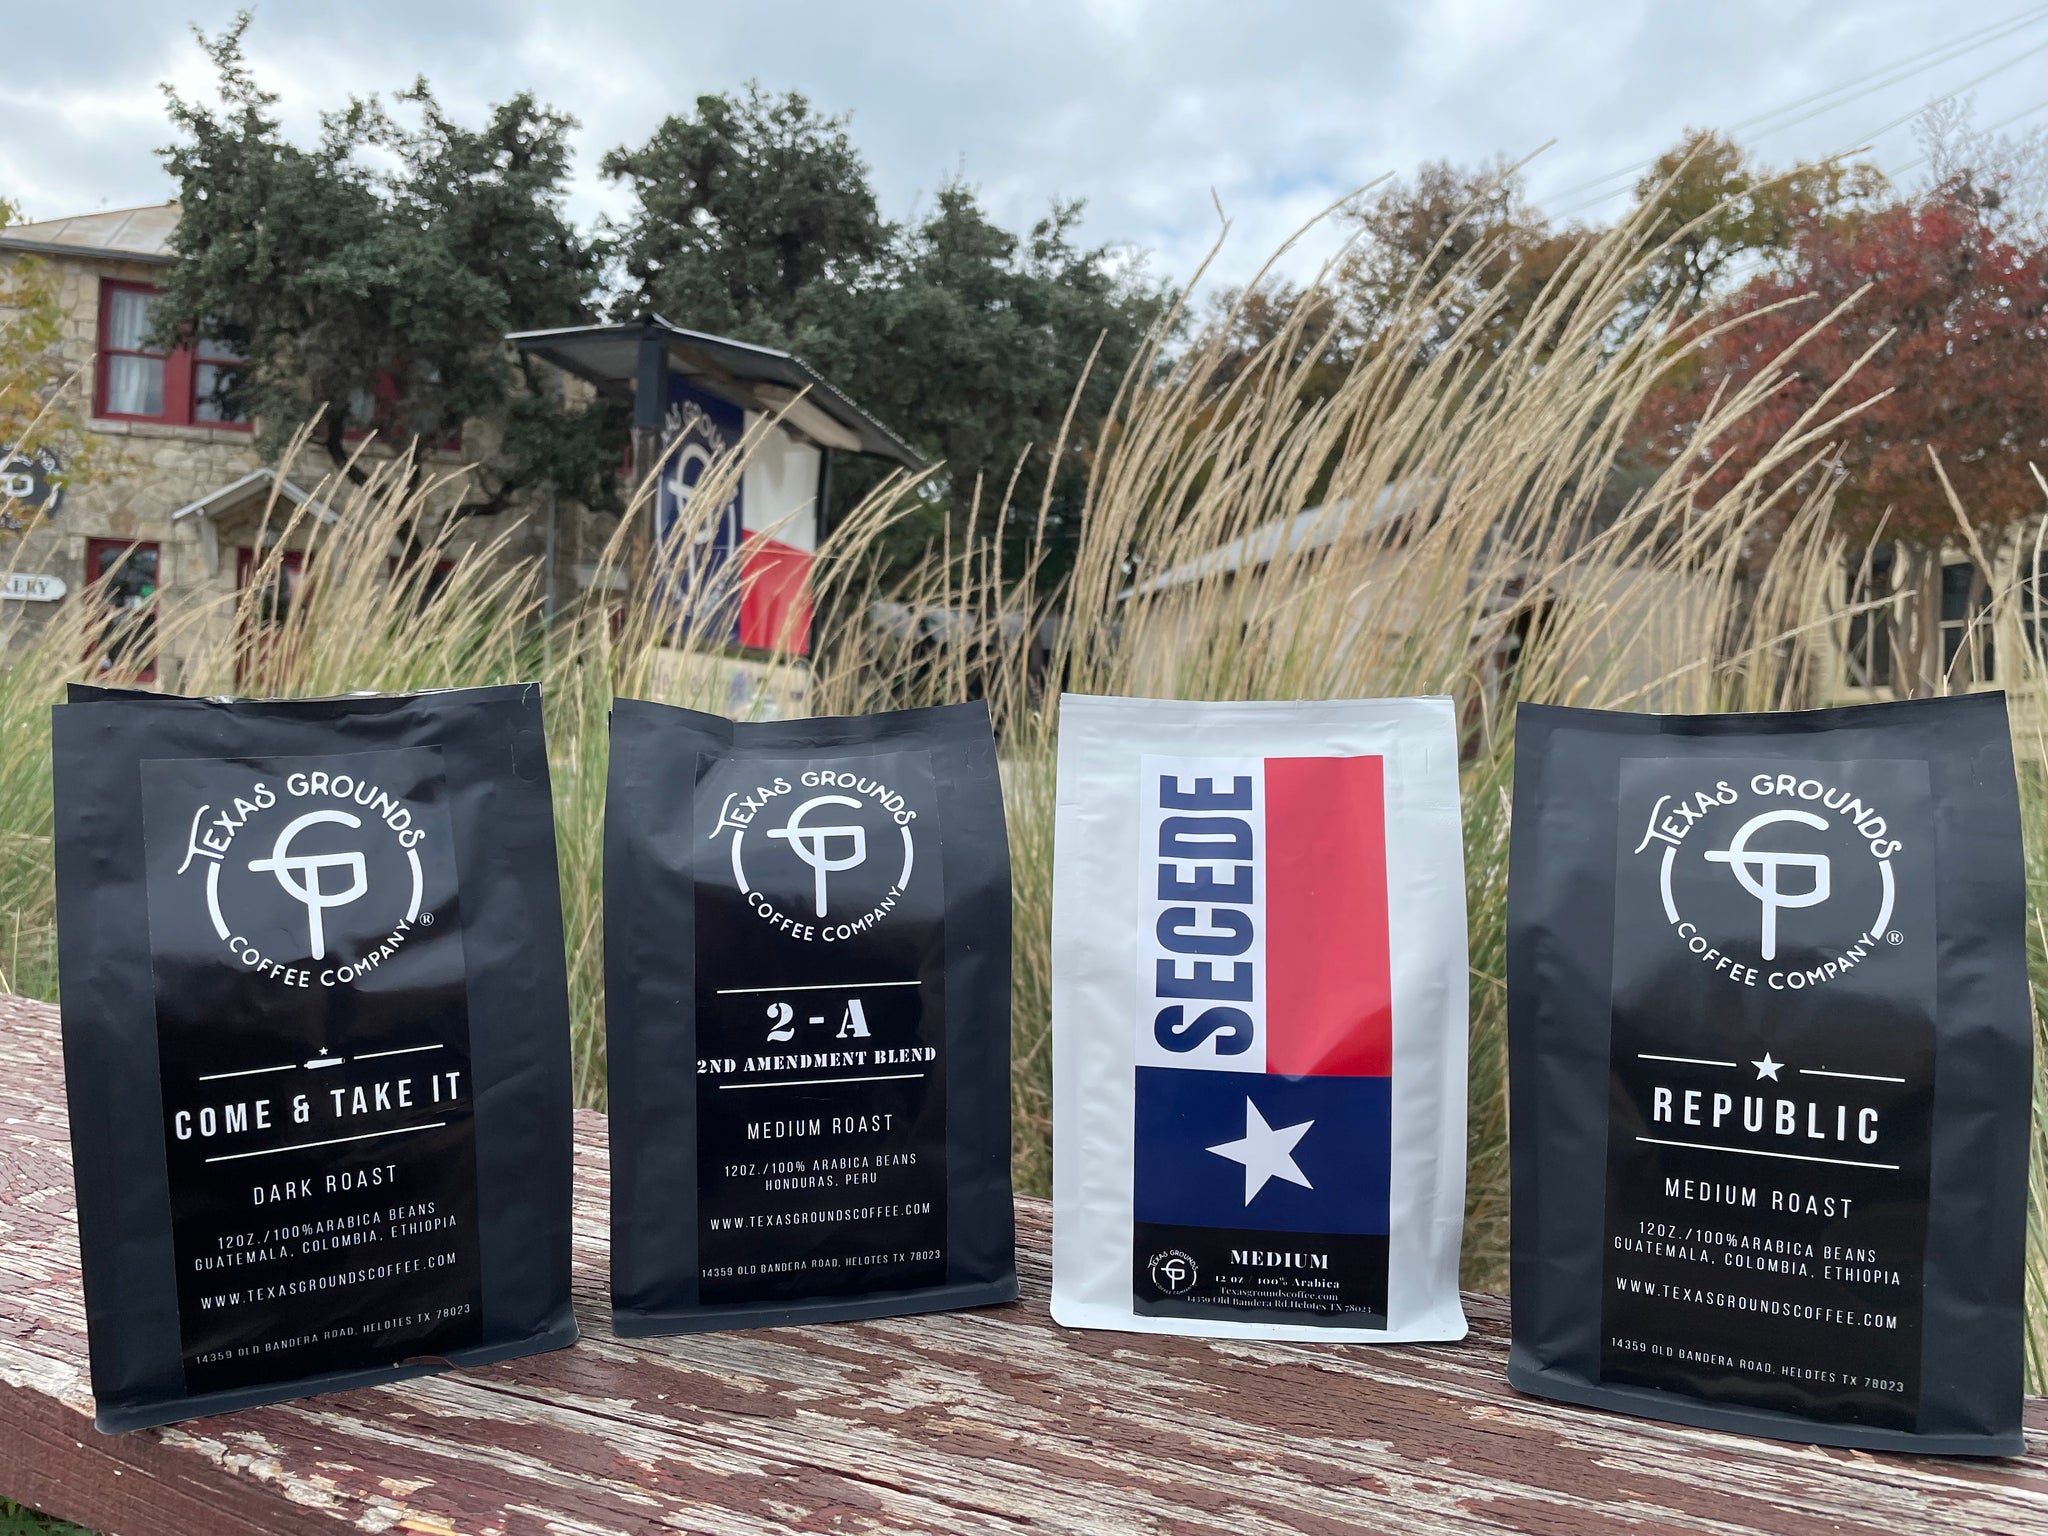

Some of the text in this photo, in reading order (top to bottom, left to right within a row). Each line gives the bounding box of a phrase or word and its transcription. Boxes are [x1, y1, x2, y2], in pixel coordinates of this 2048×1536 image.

[708, 770, 917, 839] TEXAS GROUNDS
[1634, 774, 1902, 859] TEXAS GROUNDS
[177, 771, 426, 875] TEXAS GROUNDS
[748, 886, 901, 942] COFFEE COMPANY
[1154, 774, 1254, 1055] SECEDE
[229, 936, 311, 988] COFFEE
[320, 918, 411, 987] COMPANY
[1677, 922, 1759, 987] COFFEE
[1768, 932, 1876, 990] COMPANY
[696, 1047, 937, 1074] 2ND AMENDMENT BLEND
[175, 1071, 461, 1141] COME & TAKE IT
[1653, 1086, 1879, 1145] REPUBLIC
[747, 1114, 893, 1140] MEDIUM ROAST
[813, 1156, 869, 1172] ARABICA
[876, 1153, 917, 1167] BEANS
[845, 1172, 878, 1186] PERU
[253, 1164, 397, 1206] DARK ROAST
[1665, 1177, 1852, 1219] MEDIUM ROAST
[389, 1202, 436, 1221] BEANS
[391, 1215, 457, 1238] ETHIOPIA
[710, 1202, 931, 1231] WWW.TEXASGROUNDSCOFFEE.COM
[702, 1267, 733, 1278] 14359
[737, 1265, 756, 1276] OLD
[761, 1260, 807, 1274] BANDERA
[845, 1253, 889, 1267] HELOTES
[892, 1253, 905, 1263] TX
[910, 1249, 941, 1261] 78023
[1147, 1250, 1198, 1270] TEXAS GROUNDS
[1230, 1250, 1328, 1270] MEDIUM
[1823, 1246, 1876, 1263] BEANS
[200, 1252, 457, 1310] WWW.TEXASGROUNDSCOFFEE.COM
[1215, 1275, 1226, 1283] 12
[1258, 1277, 1288, 1286] 100%
[1292, 1277, 1340, 1289] Arabica
[1220, 1286, 1339, 1301] Texasgroundscoffee.com
[1824, 1266, 1900, 1286] ETHIOPIA
[1213, 1296, 1230, 1305] Old
[1232, 1298, 1272, 1307] Bandera
[1329, 1303, 1342, 1311] TX
[1345, 1304, 1371, 1313] 78023
[1616, 1276, 1897, 1330] WWW.TEXASGROUNDSCOFFEE.COM
[196, 1350, 233, 1365] 14359
[238, 1345, 260, 1357] OLD
[265, 1334, 319, 1352] BANDERA
[363, 1315, 412, 1334] HELOTES
[417, 1312, 431, 1323] TX
[436, 1303, 471, 1319] 78023
[1611, 1337, 1647, 1353] 14359
[1651, 1344, 1673, 1357] OLD
[1678, 1348, 1734, 1368] BANDERA
[1781, 1366, 1836, 1384] HELOTES
[1842, 1374, 1857, 1386] TX
[1863, 1377, 1904, 1393] 78023
